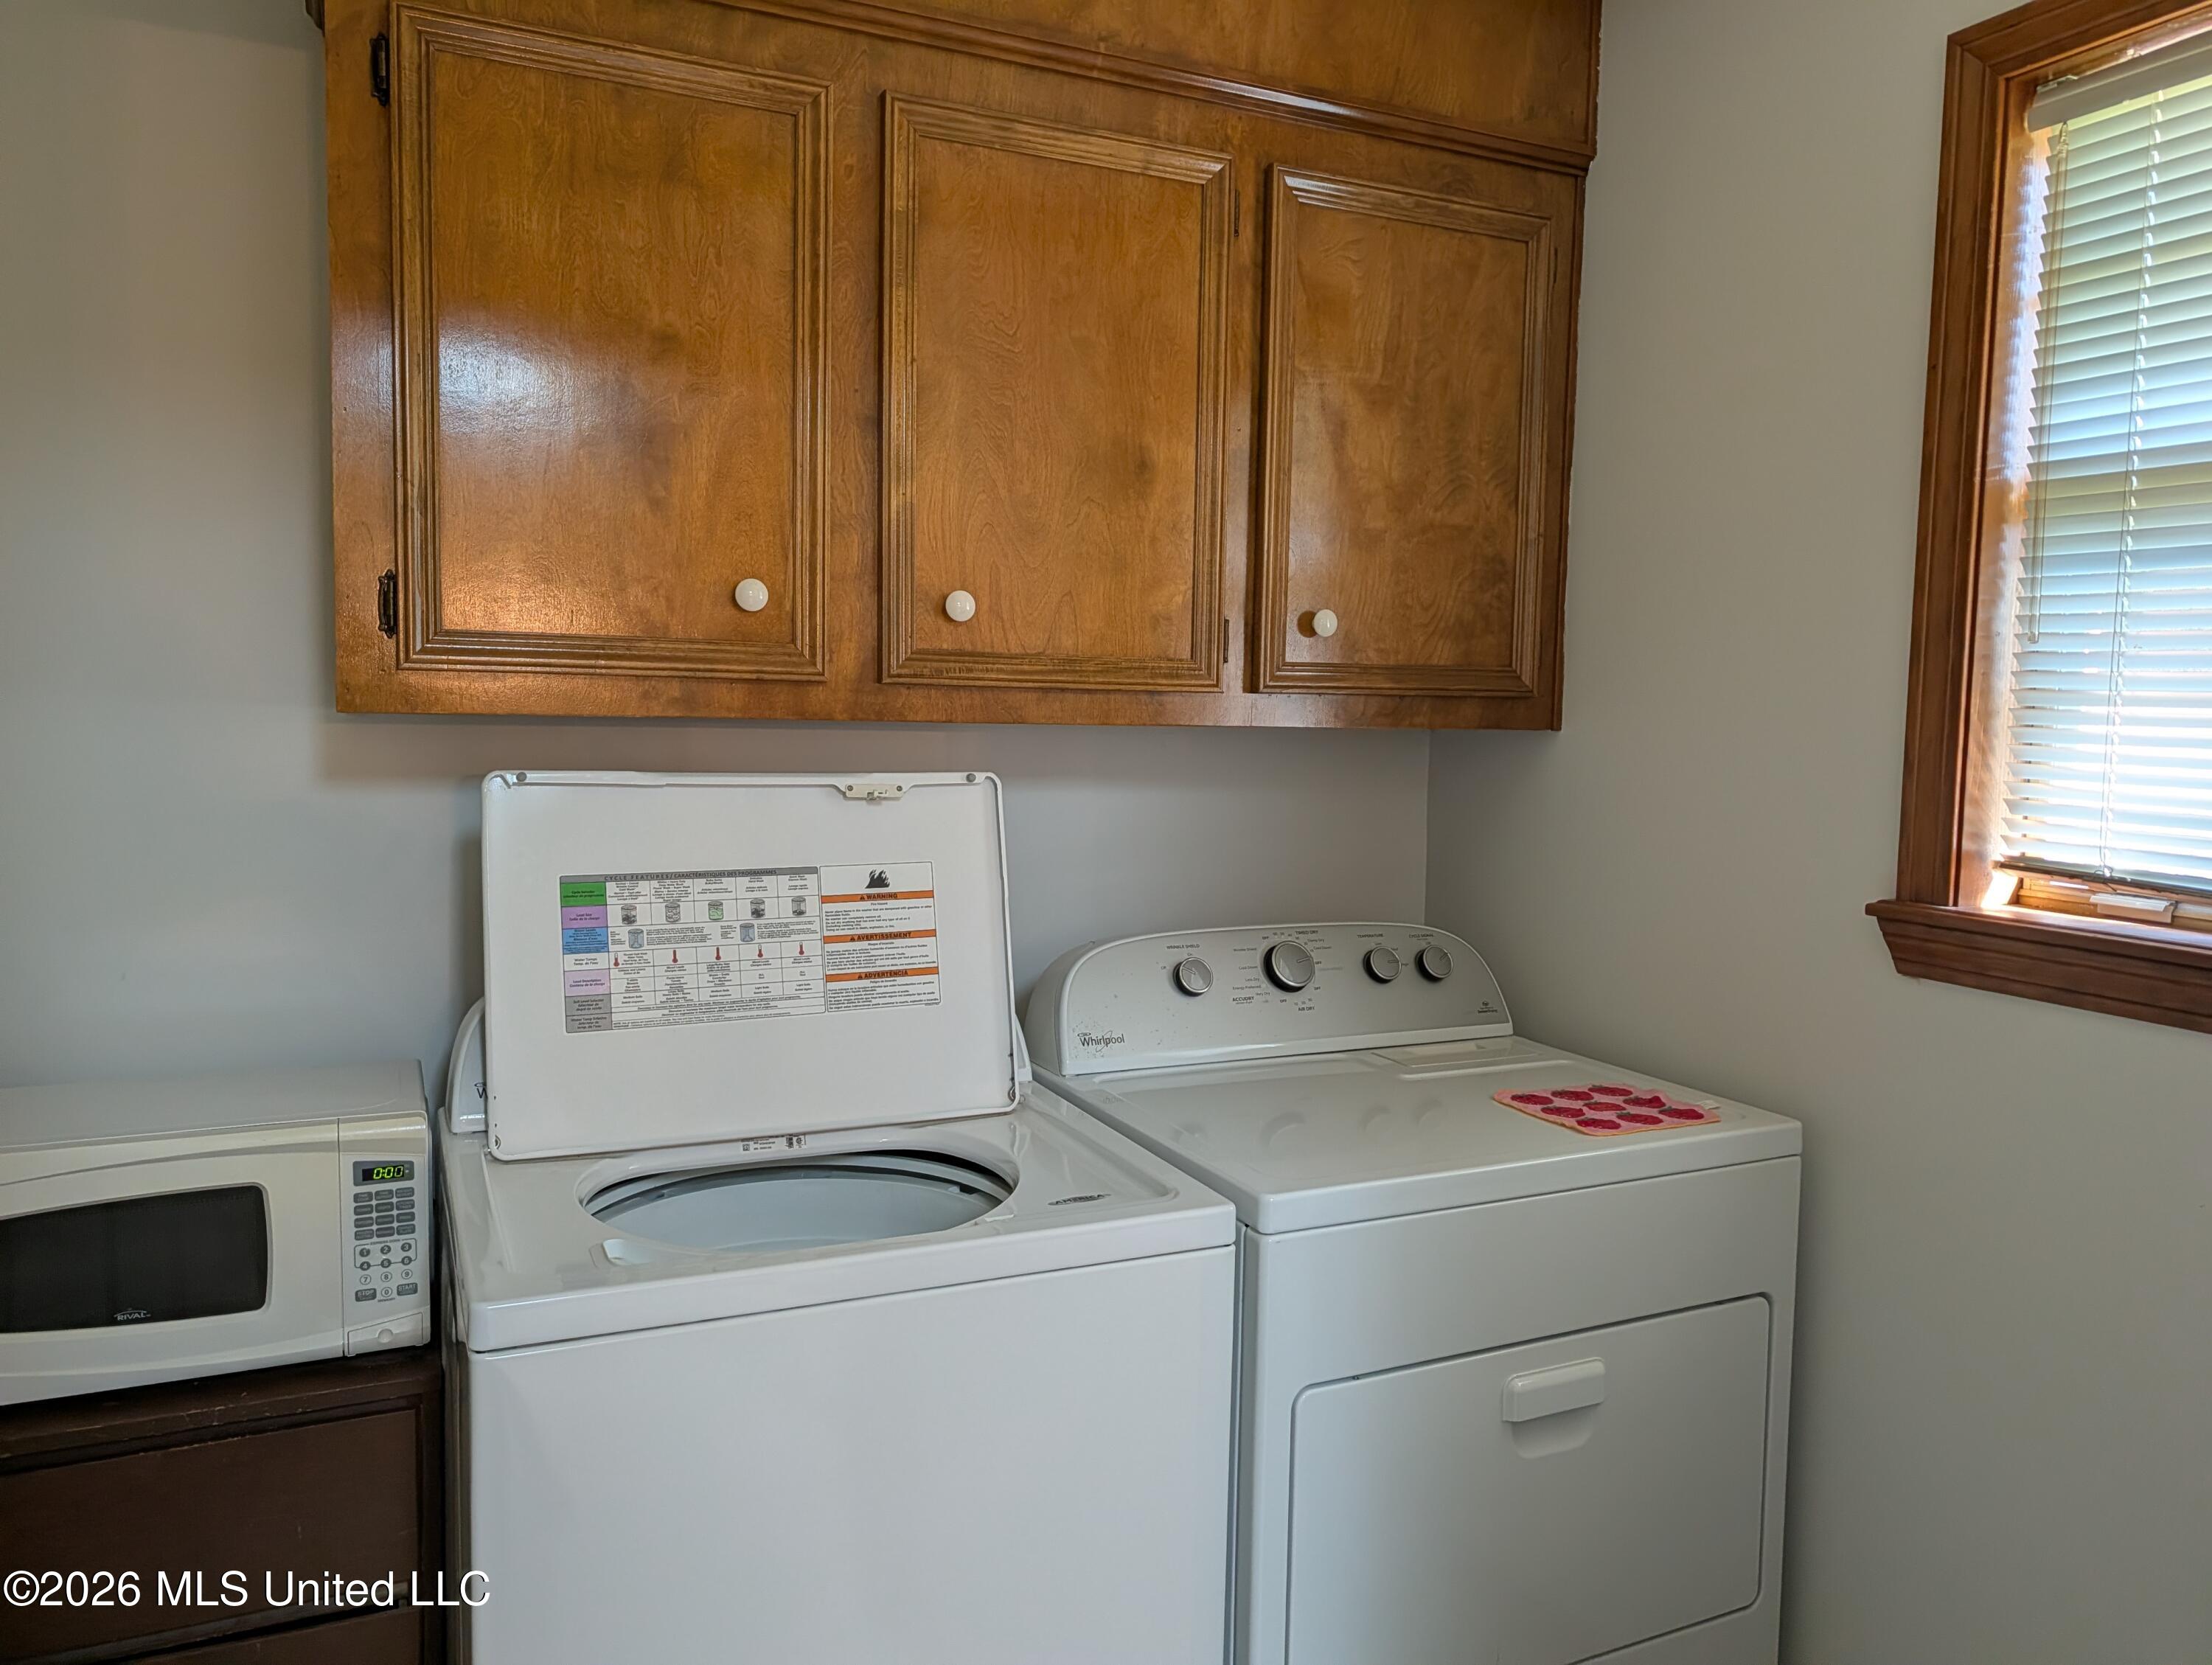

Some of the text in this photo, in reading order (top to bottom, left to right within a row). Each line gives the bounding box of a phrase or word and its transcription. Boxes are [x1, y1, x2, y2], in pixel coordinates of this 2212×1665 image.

[858, 932, 911, 940] AVERTISSEMENT
[864, 970, 908, 979] ADVERTENCIA
[1079, 1033, 1125, 1048] Whirlpool
[373, 1166, 403, 1179] 0:00
[398, 1284, 416, 1292] START
[117, 1313, 146, 1321] RIVAL
